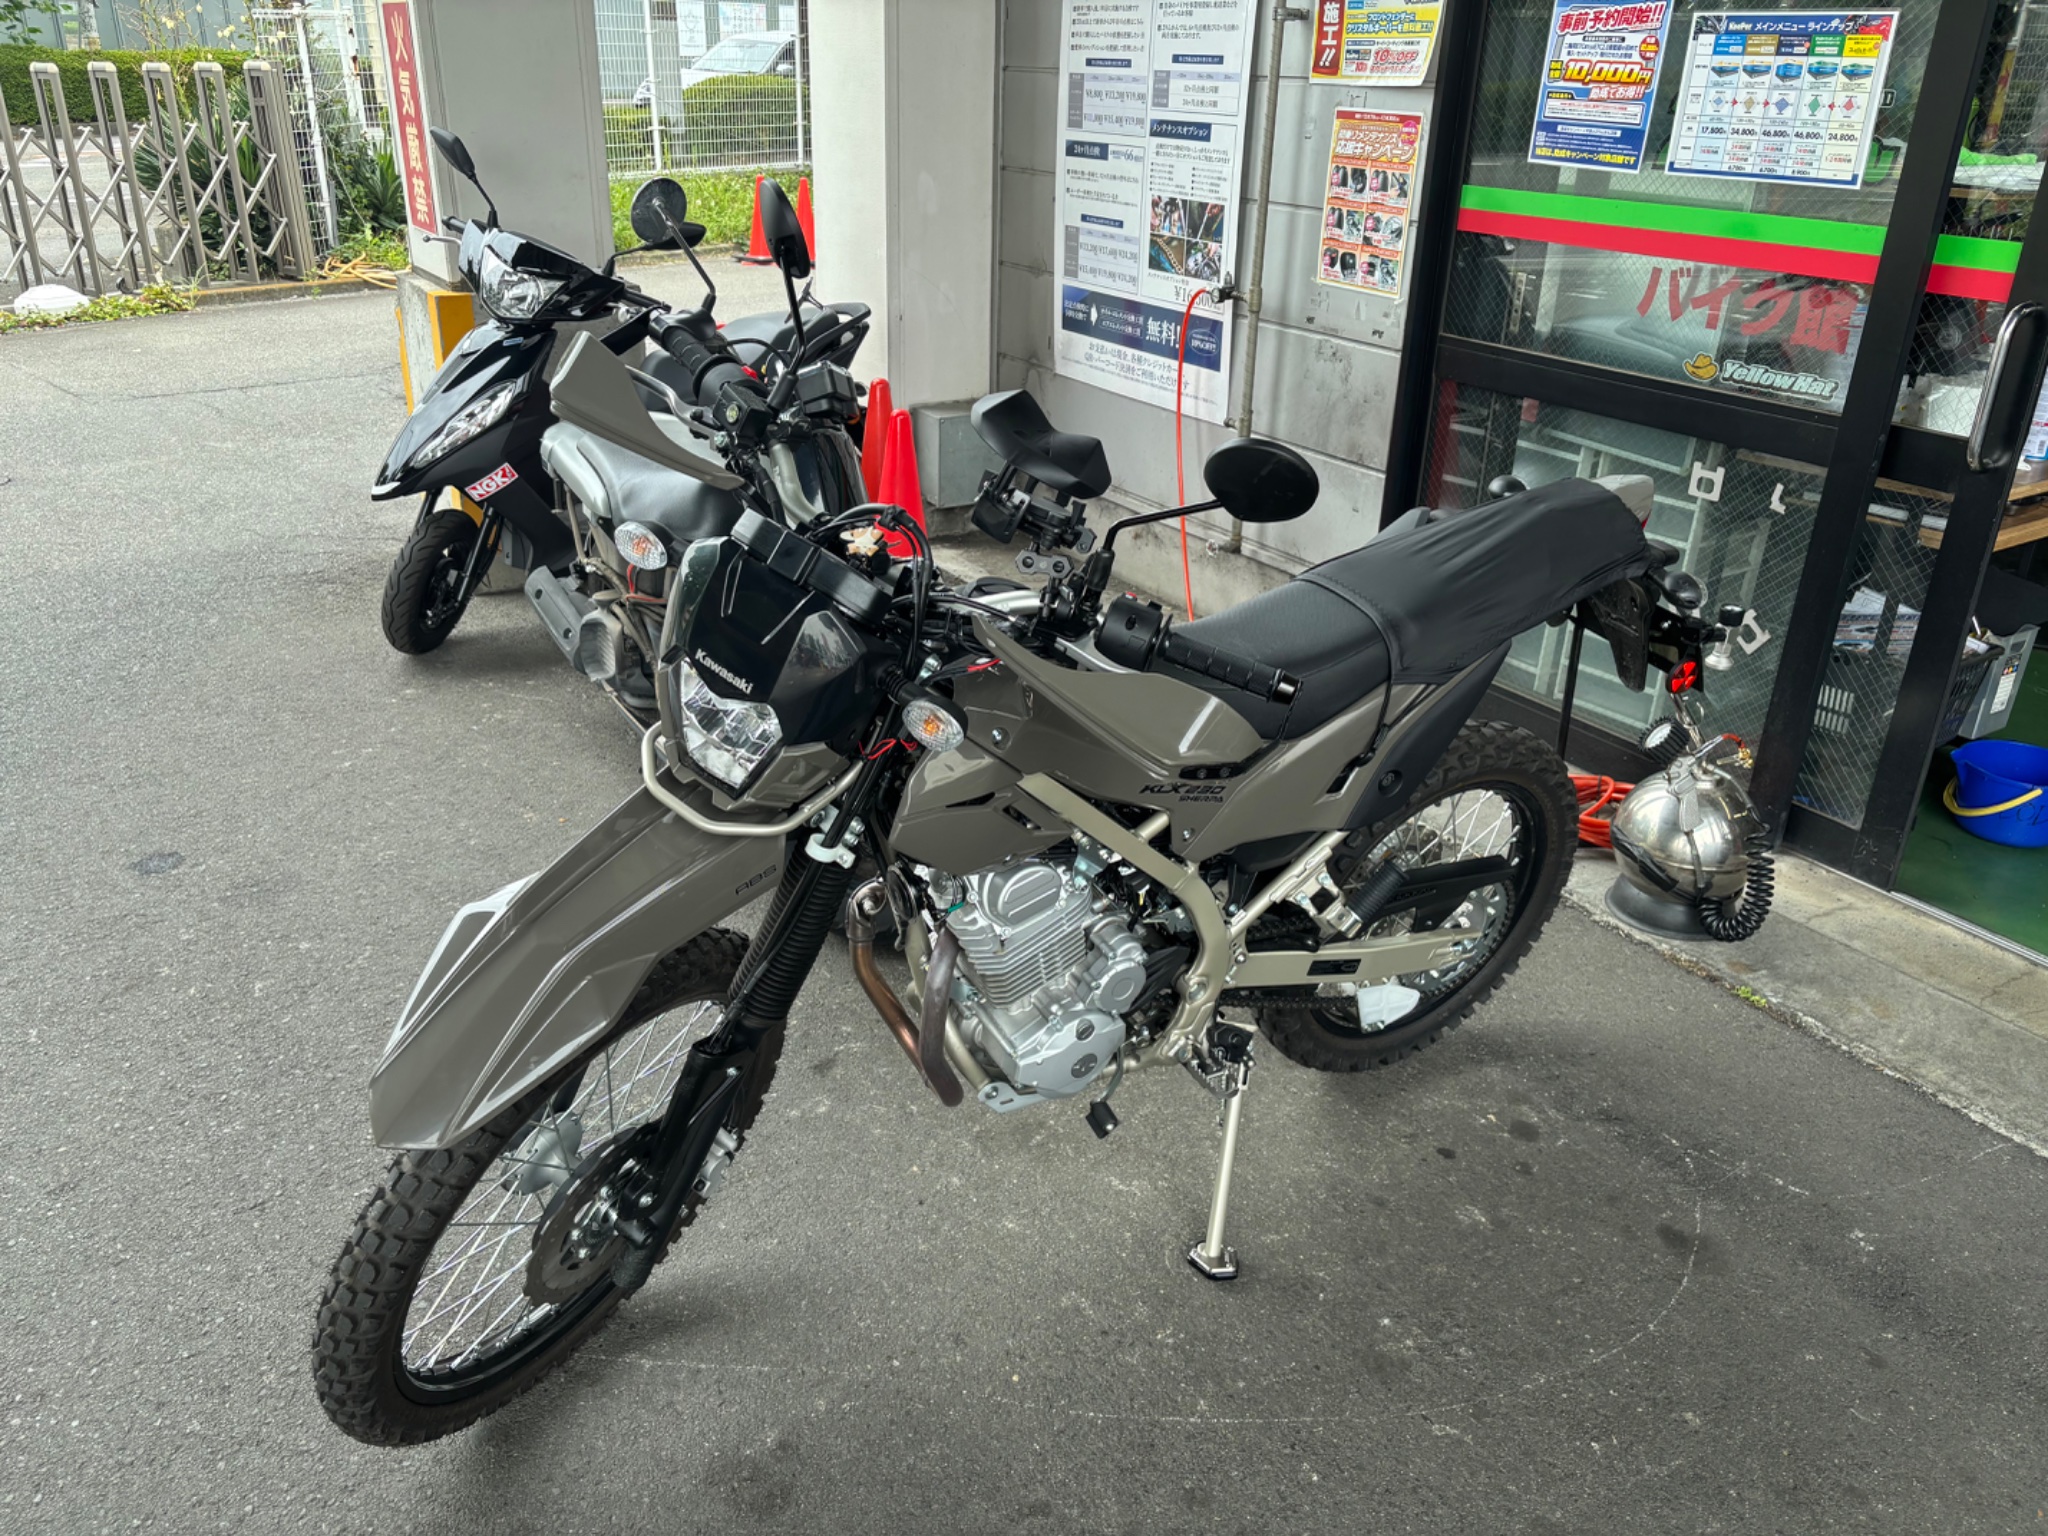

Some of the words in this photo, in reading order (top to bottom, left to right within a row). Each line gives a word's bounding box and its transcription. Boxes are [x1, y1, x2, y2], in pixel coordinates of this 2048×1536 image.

[1558, 4, 1664, 32] 事前予約開始!!
[1754, 22, 1805, 32] メインメニュー
[1373, 48, 1418, 64] 10%OFF
[1564, 60, 1652, 84] 10,000円
[1589, 86, 1646, 99] 助成でお得!!
[390, 10, 430, 225] 火気厳禁
[1152, 122, 1208, 137] メンテナンスオプション
[1637, 266, 1860, 355] バイク館
[469, 470, 510, 499] NGK
[694, 648, 754, 694] Kawasaki
[1139, 782, 1190, 794] KLX
[1184, 786, 1226, 794] 230
[736, 864, 776, 896] ABS
